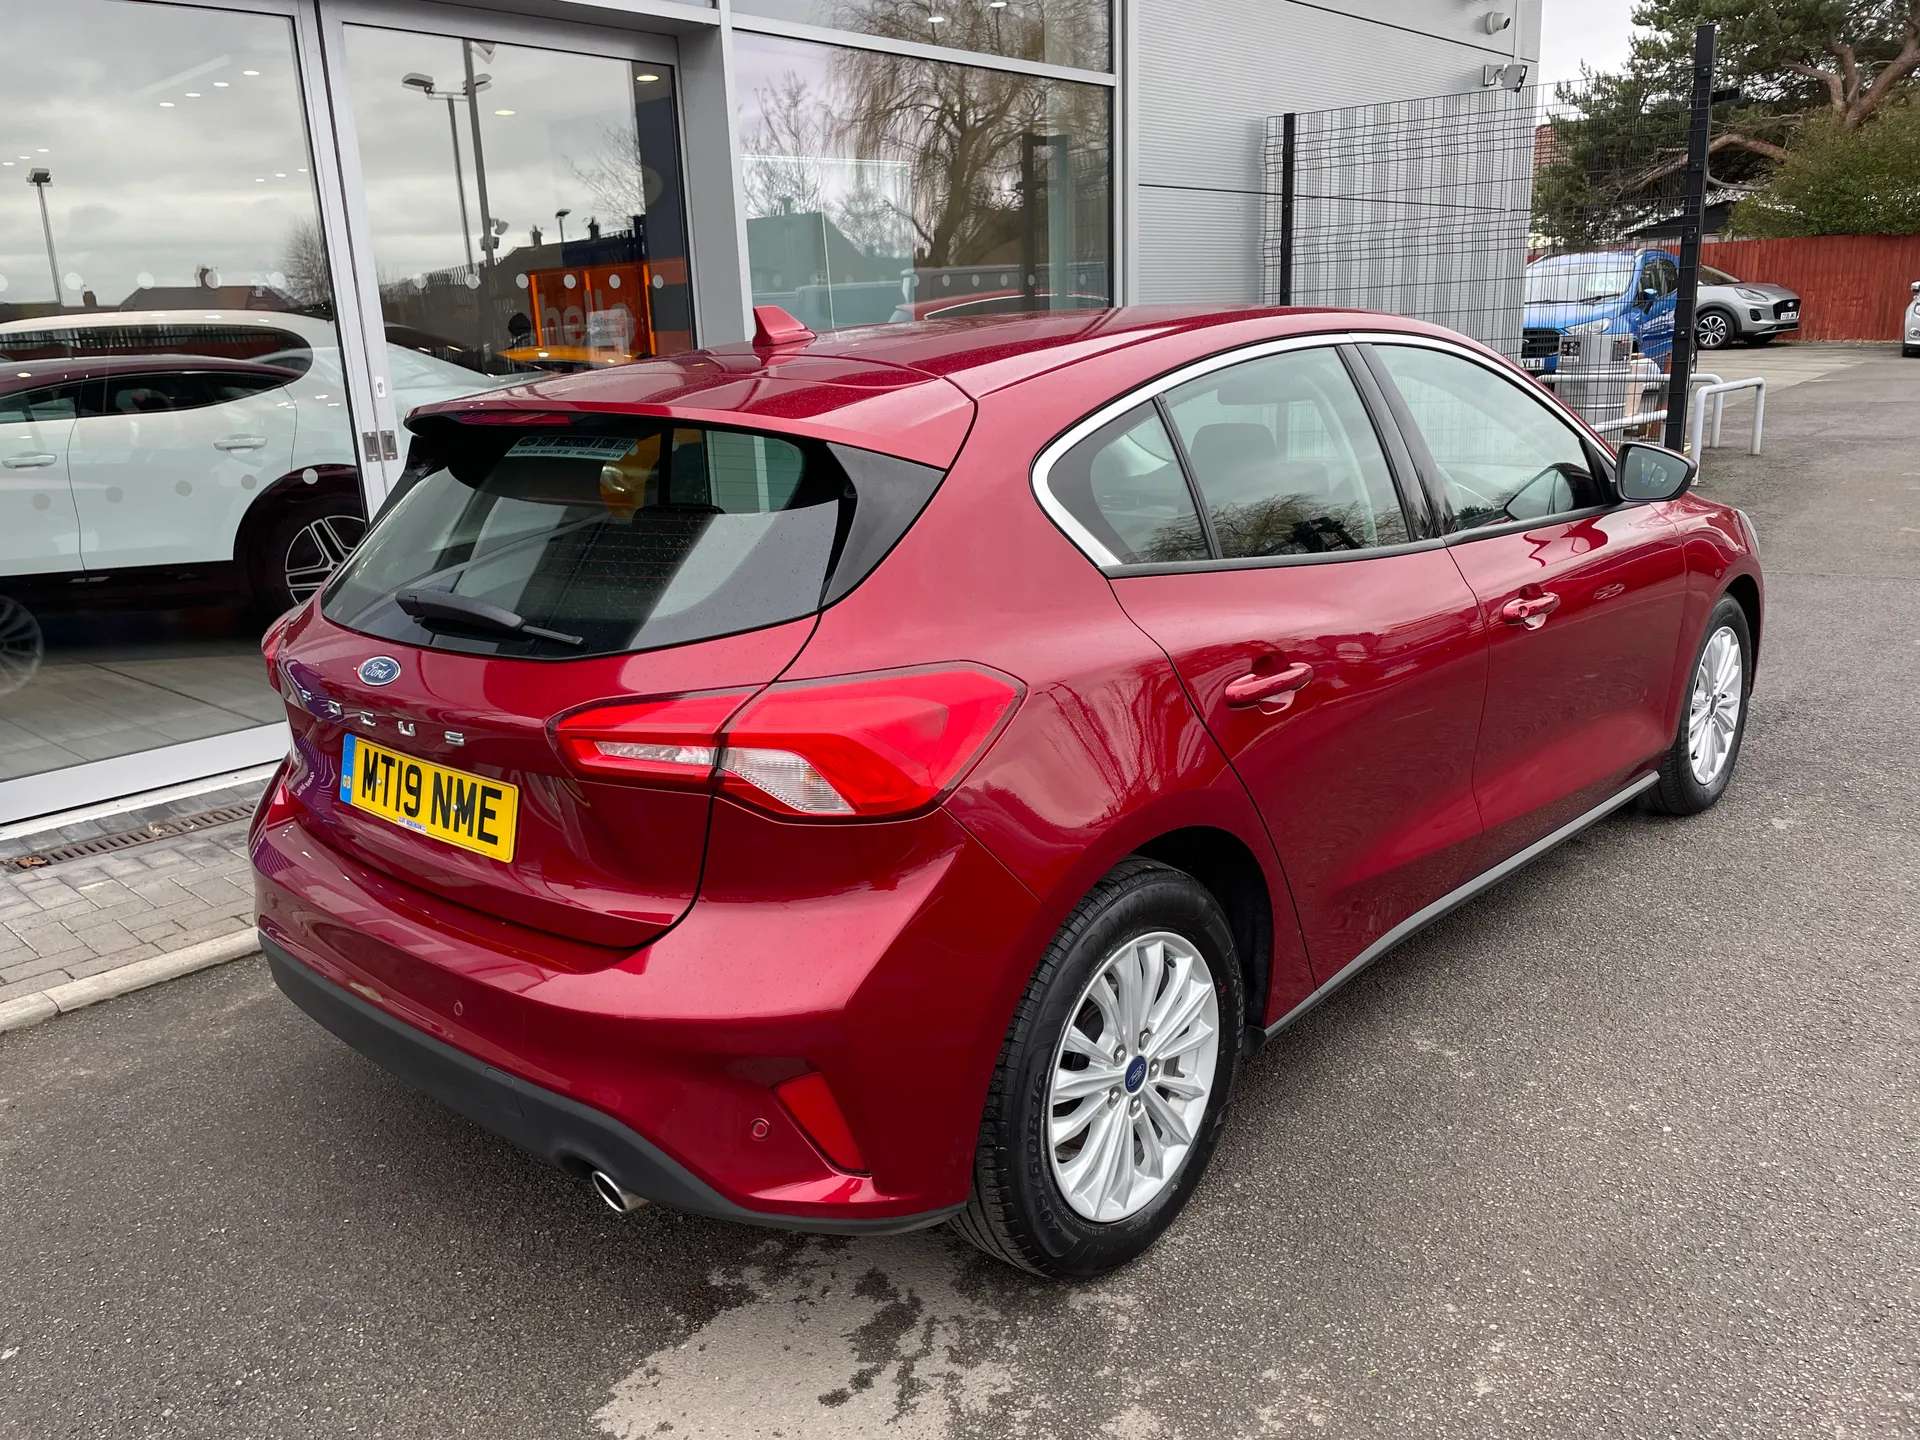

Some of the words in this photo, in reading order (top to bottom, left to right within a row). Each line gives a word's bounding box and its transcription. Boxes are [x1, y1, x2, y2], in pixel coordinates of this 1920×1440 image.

[301, 689, 465, 746] FOCUS
[362, 749, 422, 818] MT19
[431, 772, 503, 846] NME
